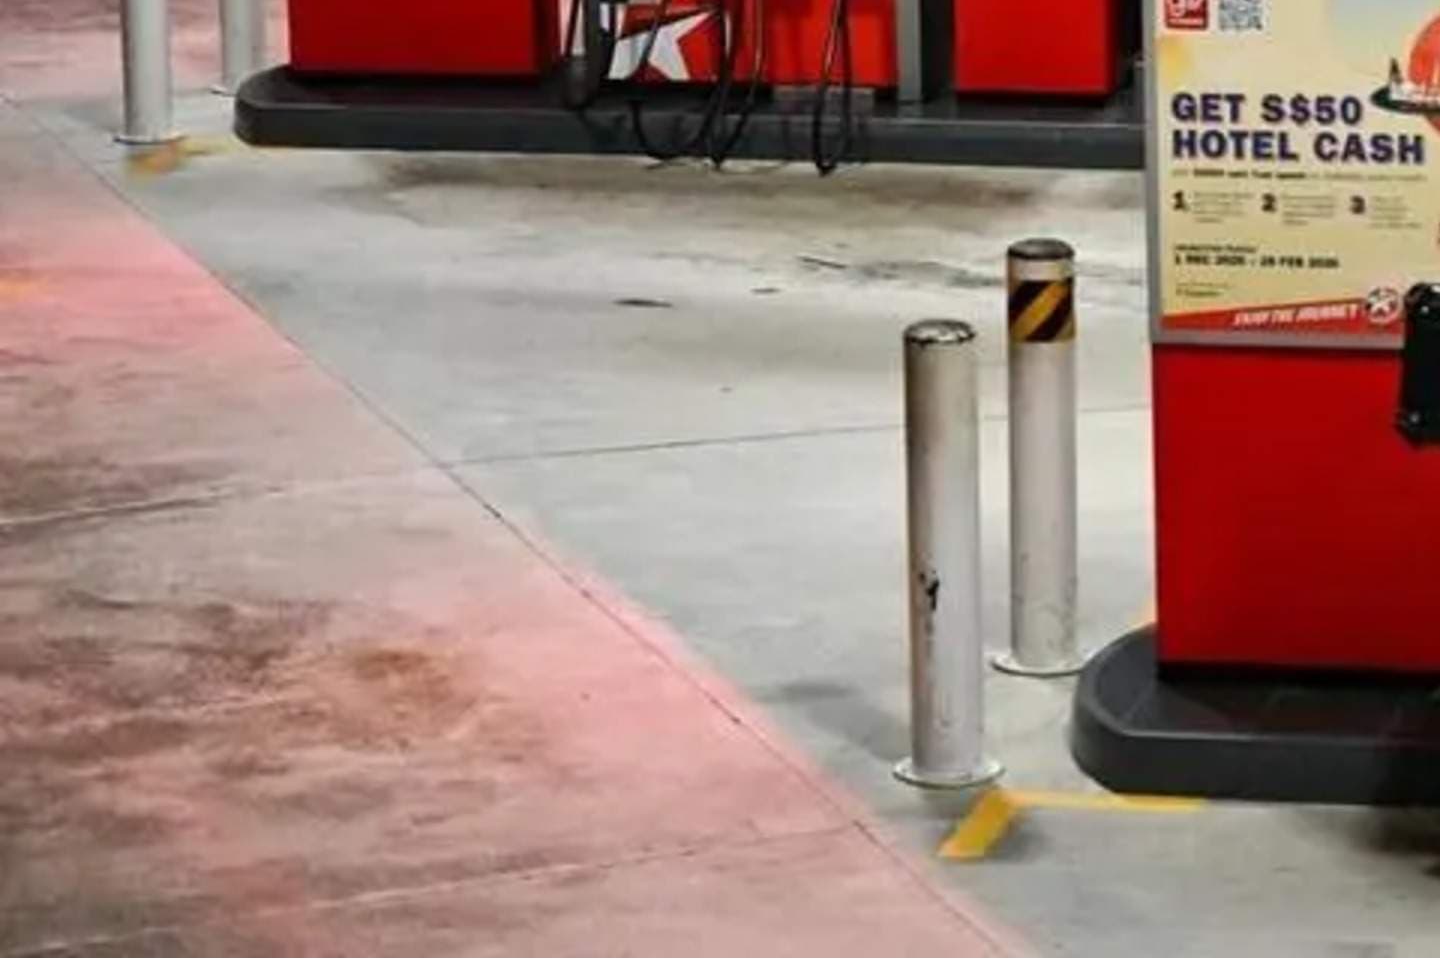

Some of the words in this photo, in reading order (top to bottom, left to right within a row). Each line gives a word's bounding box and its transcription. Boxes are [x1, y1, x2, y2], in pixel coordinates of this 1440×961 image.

[1171, 93, 1246, 123] GET
[1260, 93, 1363, 126] S$50
[1172, 129, 1300, 160] HOTEL
[1313, 131, 1424, 164] CASH
